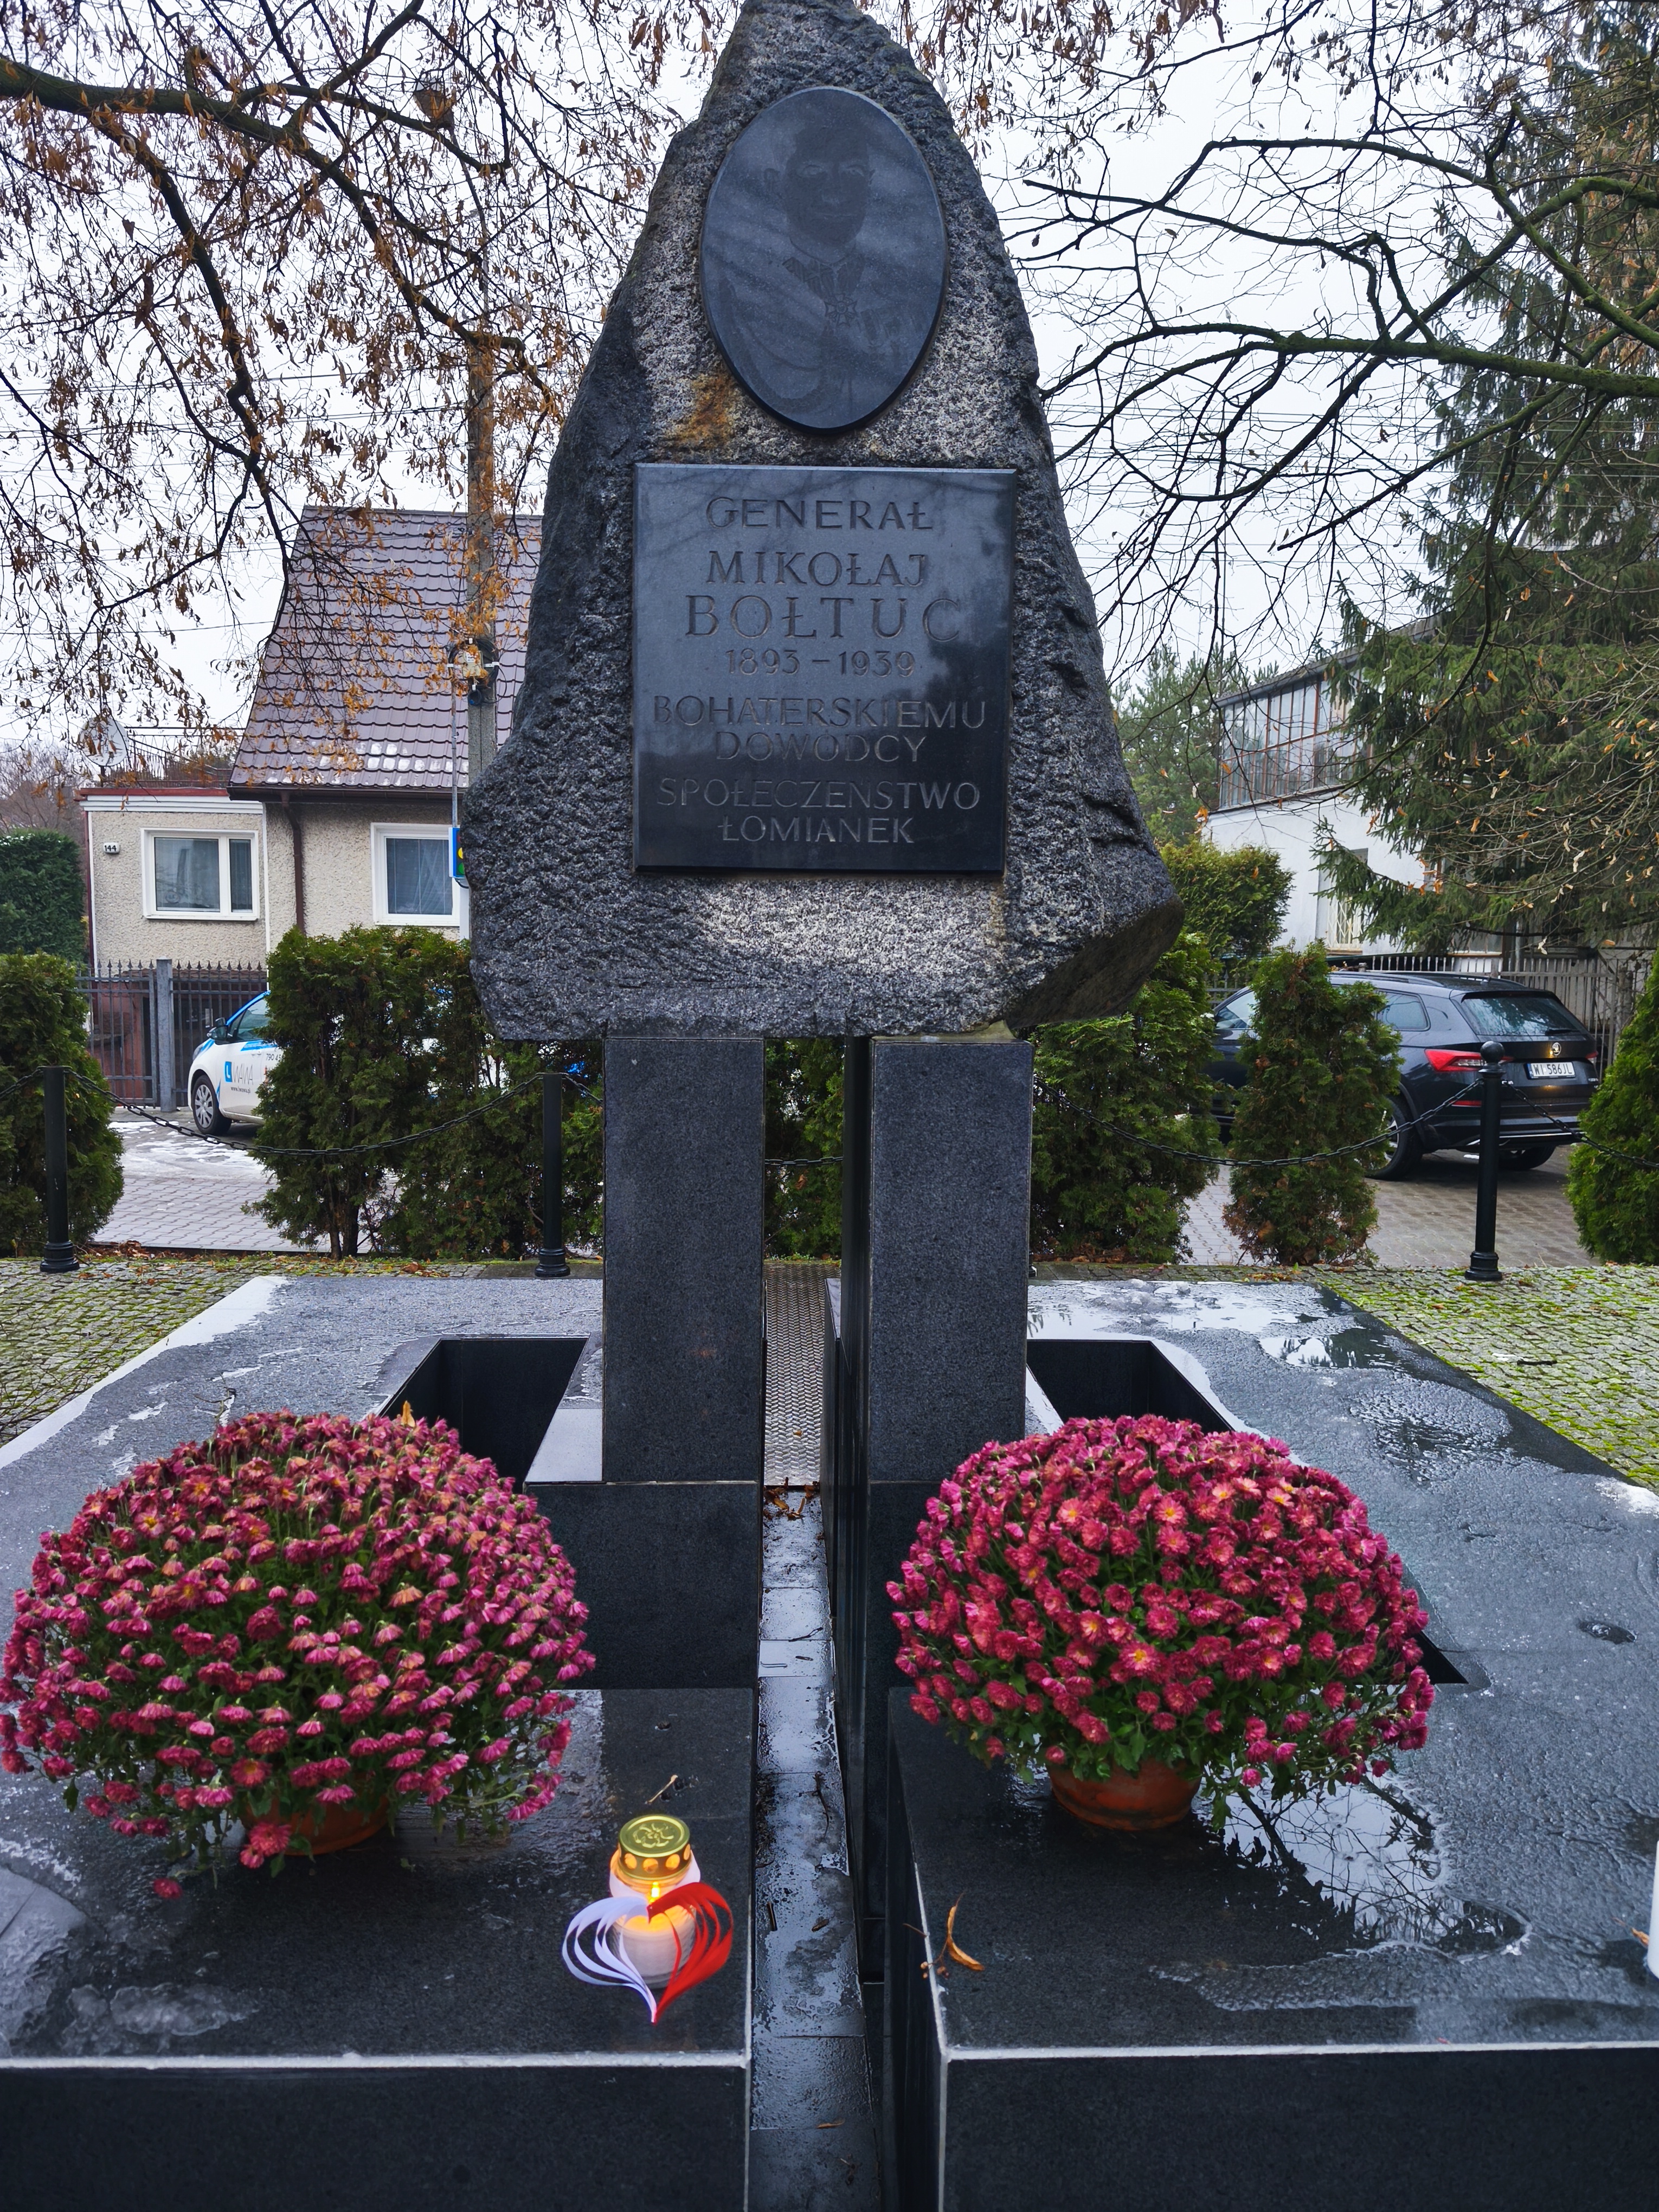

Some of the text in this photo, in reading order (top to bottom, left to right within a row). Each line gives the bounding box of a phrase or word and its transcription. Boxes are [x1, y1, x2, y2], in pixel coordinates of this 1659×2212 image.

[706, 496, 933, 531] GENERAŁ
[706, 550, 928, 587] MIKOŁAJ
[725, 648, 800, 675] 1893
[838, 651, 915, 677] 1939
[653, 695, 986, 729] BOHATERSKIEMU
[717, 815, 915, 844] ŁOMIANEK
[266, 1053, 274, 1061] 790
